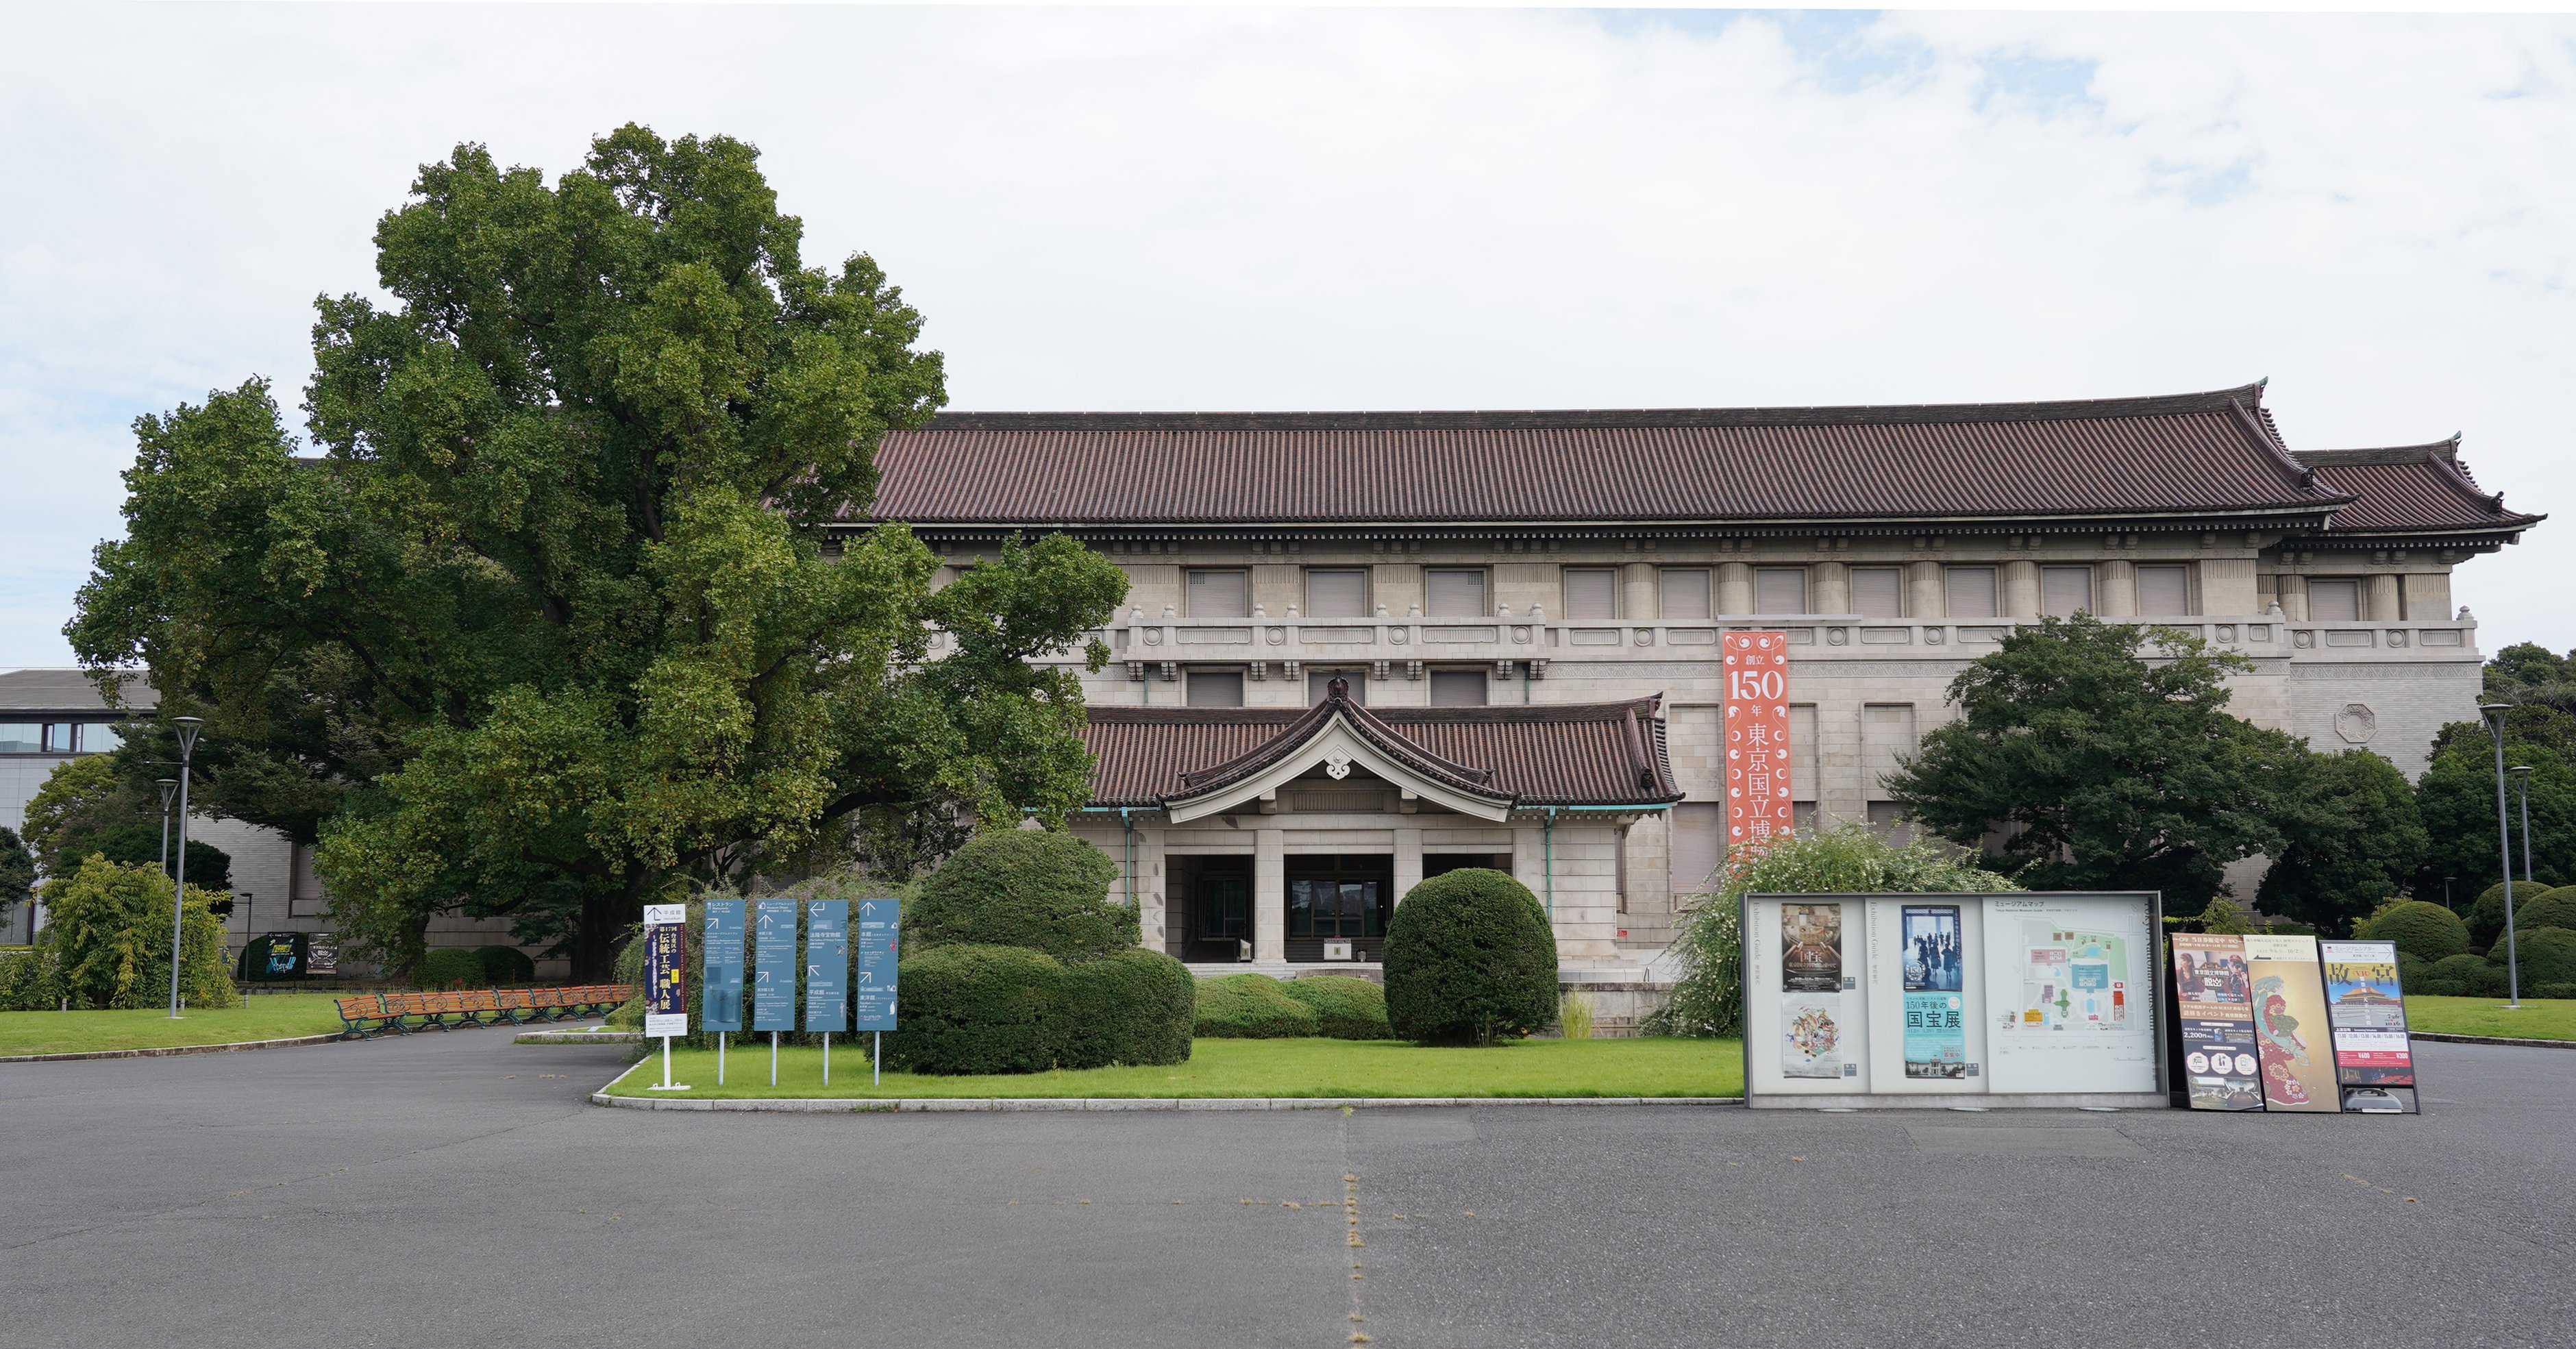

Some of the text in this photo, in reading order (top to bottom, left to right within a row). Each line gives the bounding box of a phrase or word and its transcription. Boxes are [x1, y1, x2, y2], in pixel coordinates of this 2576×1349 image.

[1745, 654, 1765, 665] 創立
[1729, 670, 1784, 700] 150
[1751, 704, 1762, 717] 年
[1800, 951, 1822, 962] 国宝
[659, 933, 671, 1010] 伝統工芸 職人展
[2329, 963, 2352, 985] 故
[2371, 963, 2394, 986] 宮
[2204, 978, 2222, 987] 脱出
[1906, 1001, 1947, 1009] 150年後の
[1907, 1011, 1961, 1028] 国宝展
